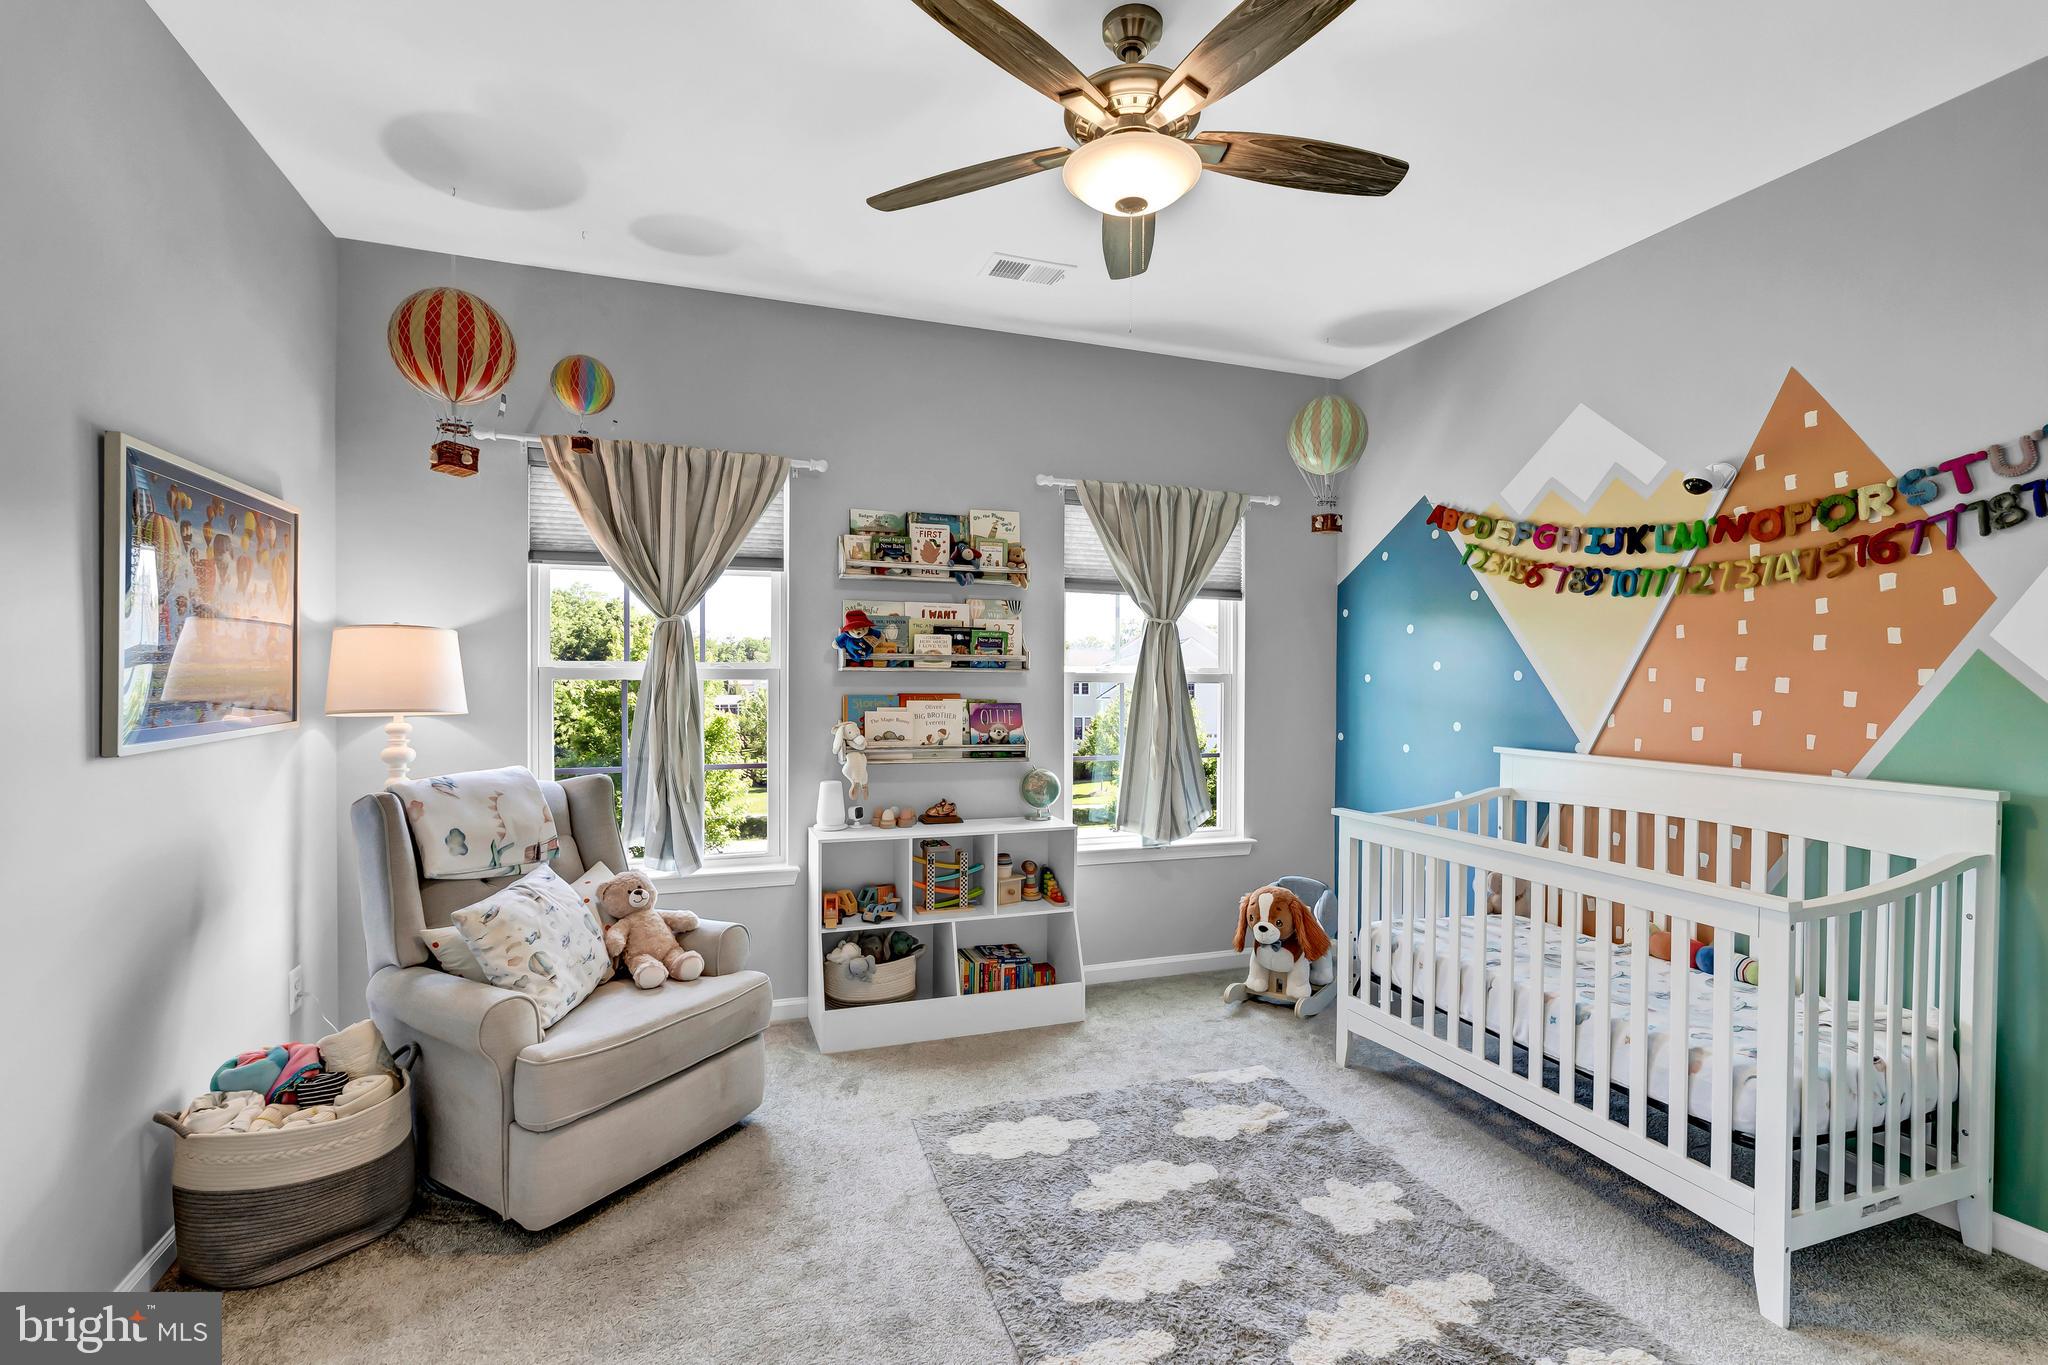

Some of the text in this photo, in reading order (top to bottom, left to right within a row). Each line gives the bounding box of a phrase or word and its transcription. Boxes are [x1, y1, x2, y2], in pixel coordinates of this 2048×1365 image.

[919, 530, 943, 539] FIRST
[892, 543, 905, 551] Baby
[921, 608, 958, 620] I WANT
[1006, 623, 1015, 635] 3
[926, 711, 957, 720] BROTHER
[980, 709, 1014, 726] OLLIE
